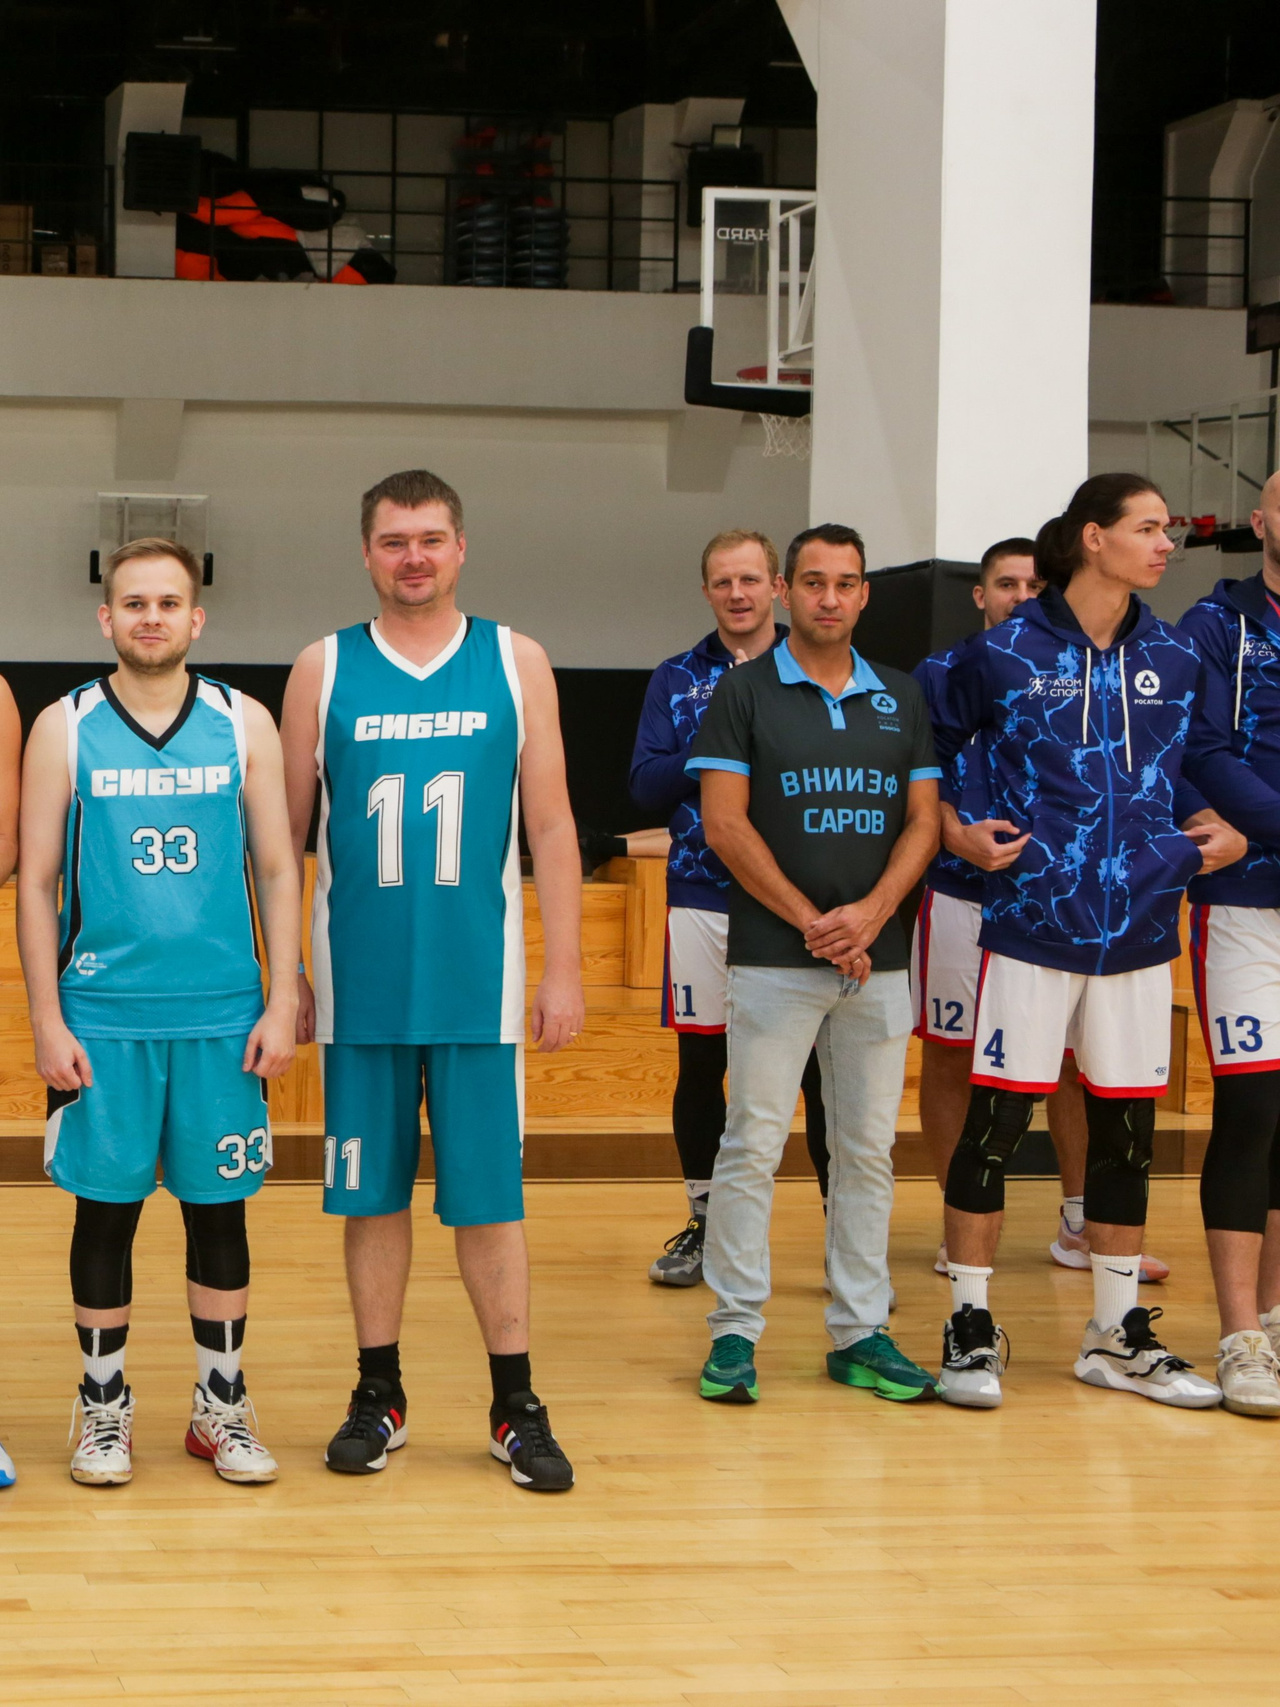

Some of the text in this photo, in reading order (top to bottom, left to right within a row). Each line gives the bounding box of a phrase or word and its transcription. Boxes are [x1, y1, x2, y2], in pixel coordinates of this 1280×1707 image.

[1049, 688, 1085, 698] СПОРТ
[1053, 679, 1082, 687] АТОМ
[354, 711, 488, 742] СИБУР
[91, 765, 230, 798] СИБУР
[780, 767, 898, 799] ВНИИЭФ
[367, 771, 465, 888] 11
[803, 808, 885, 835] САРОВ
[131, 825, 199, 875] 33
[673, 983, 696, 1017] 11
[932, 998, 964, 1032] 12
[983, 1027, 1005, 1069] 4
[1215, 1015, 1263, 1055] 13
[216, 1126, 268, 1181] 33
[324, 1136, 361, 1190] 11
